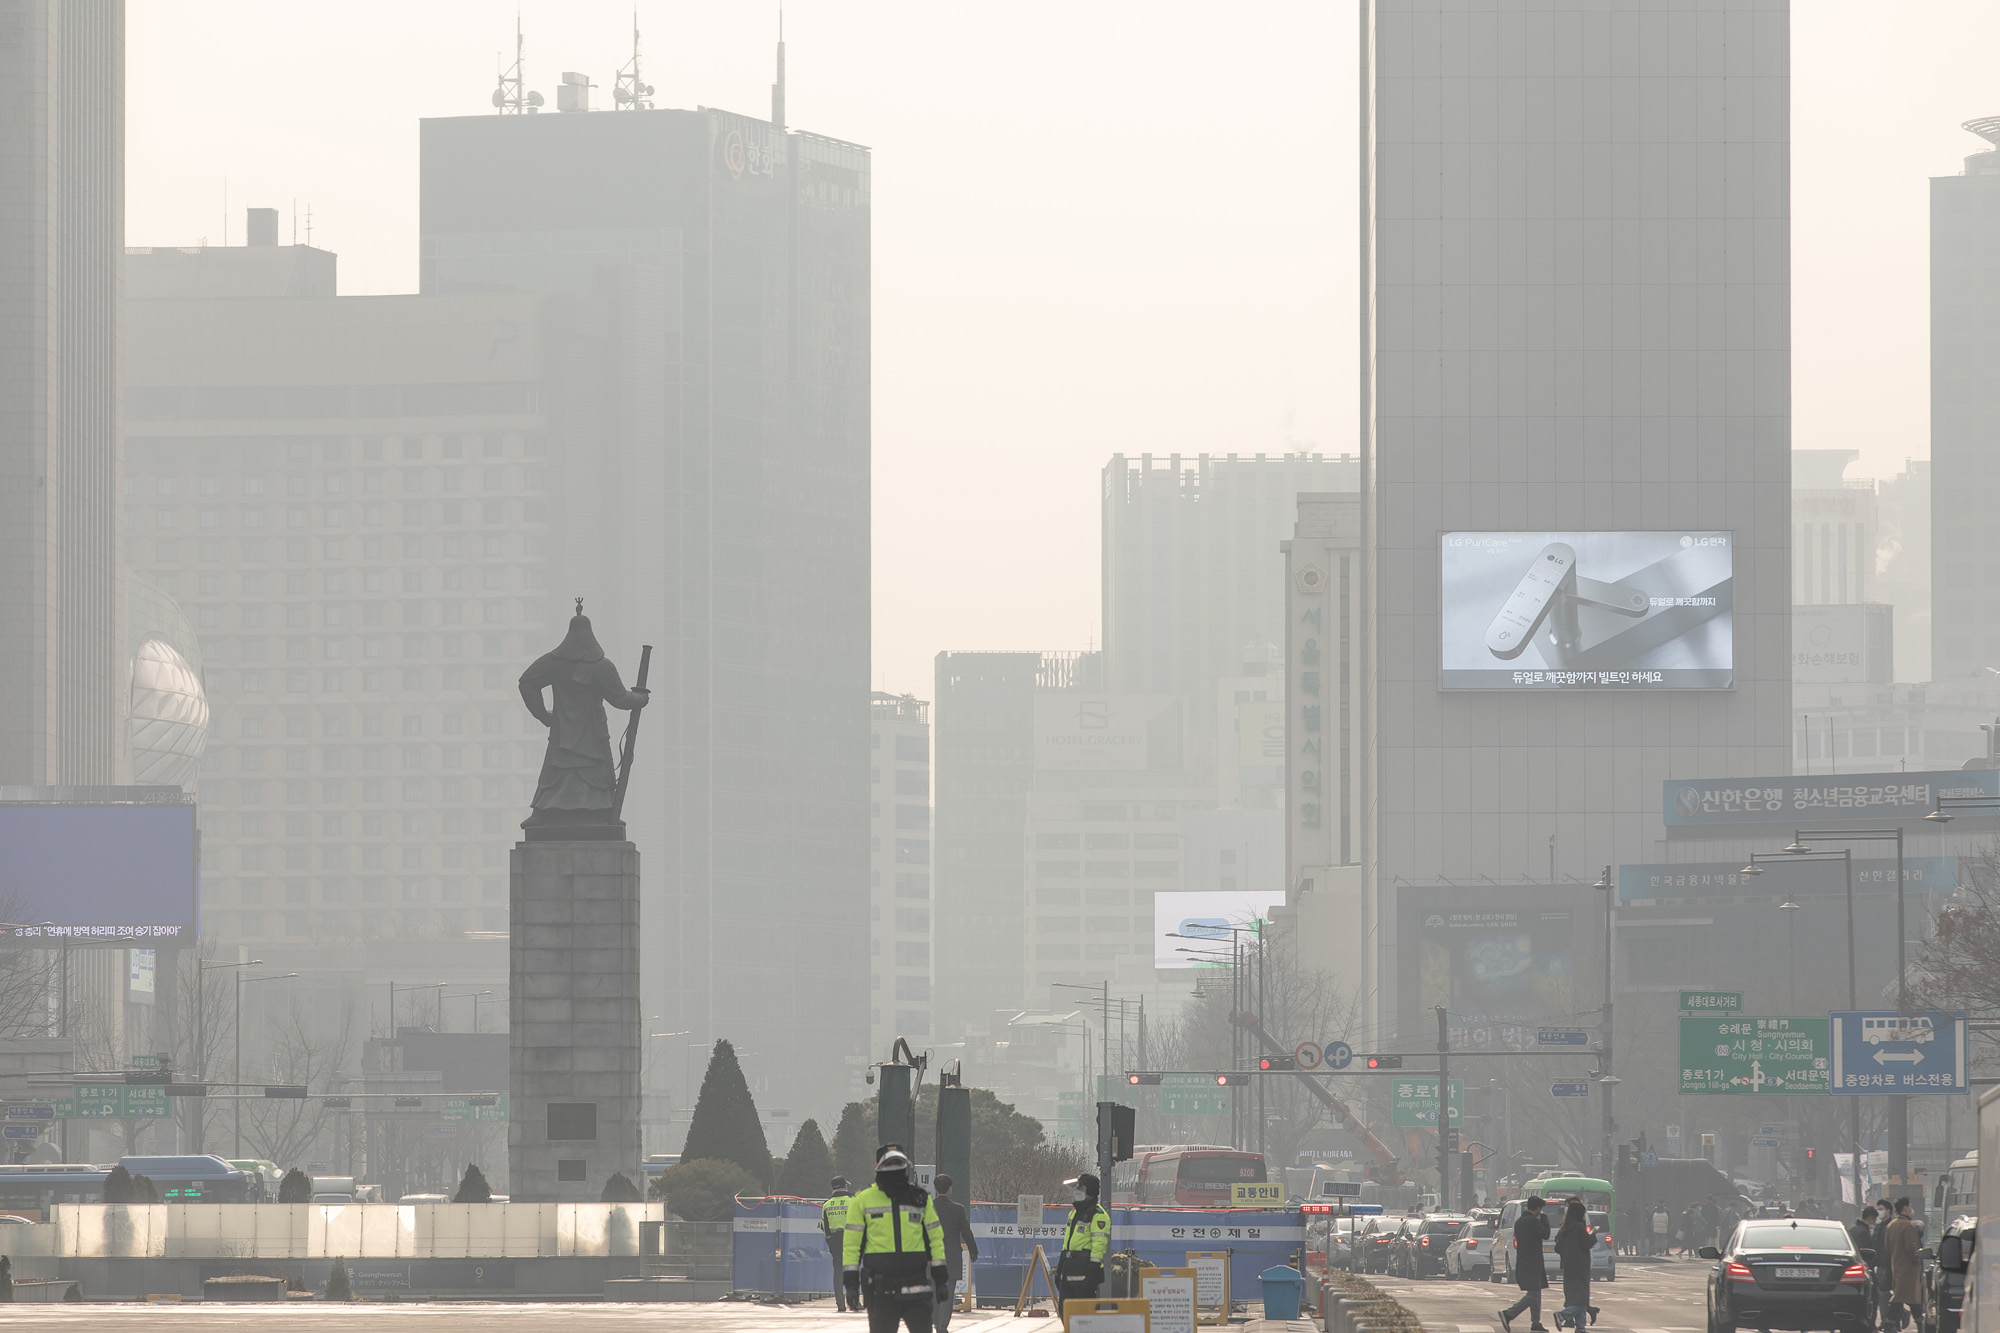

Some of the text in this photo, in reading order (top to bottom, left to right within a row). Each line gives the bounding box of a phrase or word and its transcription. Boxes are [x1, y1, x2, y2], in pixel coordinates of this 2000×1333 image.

[1449, 539, 1463, 547] LG
[1466, 539, 1508, 547] PuriCare
[1649, 597, 1716, 606] 듀얼로 깨끗함까지
[1512, 671, 1663, 684] 듀얼로 깨끗함까지 빌트인 하세요
[1302, 607, 1321, 830] 서울특별시의회
[1046, 735, 1143, 746] HOTEL GRACERY
[1700, 788, 1784, 813] 신한은행
[1792, 784, 1930, 810] 청소년금융교육센터
[1650, 873, 1752, 887] 한국금융사박물관
[73, 926, 90, 936] 방역
[91, 926, 115, 936] 허리띠
[117, 926, 133, 936] 조여
[135, 926, 151, 936] 승기
[1688, 996, 1737, 1007] 세종대로사거리
[1718, 1019, 1789, 1035] 숭례문 崇禮門
[1757, 1031, 1806, 1039] Sungnyemun
[1775, 1039, 1813, 1051] 시의회
[1718, 1047, 1727, 1055] 60
[1682, 1069, 1725, 1080] 종로1가
[1785, 1070, 1830, 1081] 서대문역
[1845, 1074, 1896, 1087] 중앙차로
[1903, 1073, 1954, 1087] 버스전용
[1397, 1084, 1455, 1098] 종로1가
[1682, 1082, 1706, 1090] Jongno
[80, 1088, 118, 1097] 종로1가
[128, 1089, 166, 1099] 서대문역
[1397, 1100, 1420, 1109] Jongno
[1299, 1150, 1353, 1158] HOTEL KOREANA
[1239, 1168, 1255, 1177] 9200
[1237, 1187, 1279, 1198] 교통안내
[990, 1226, 1014, 1235] 새로운
[1017, 1226, 1057, 1236] 광화문광장
[1171, 1227, 1261, 1239] 안전 제일
[358, 1271, 402, 1279] Gwanghwamun
[475, 1267, 483, 1279] 9
